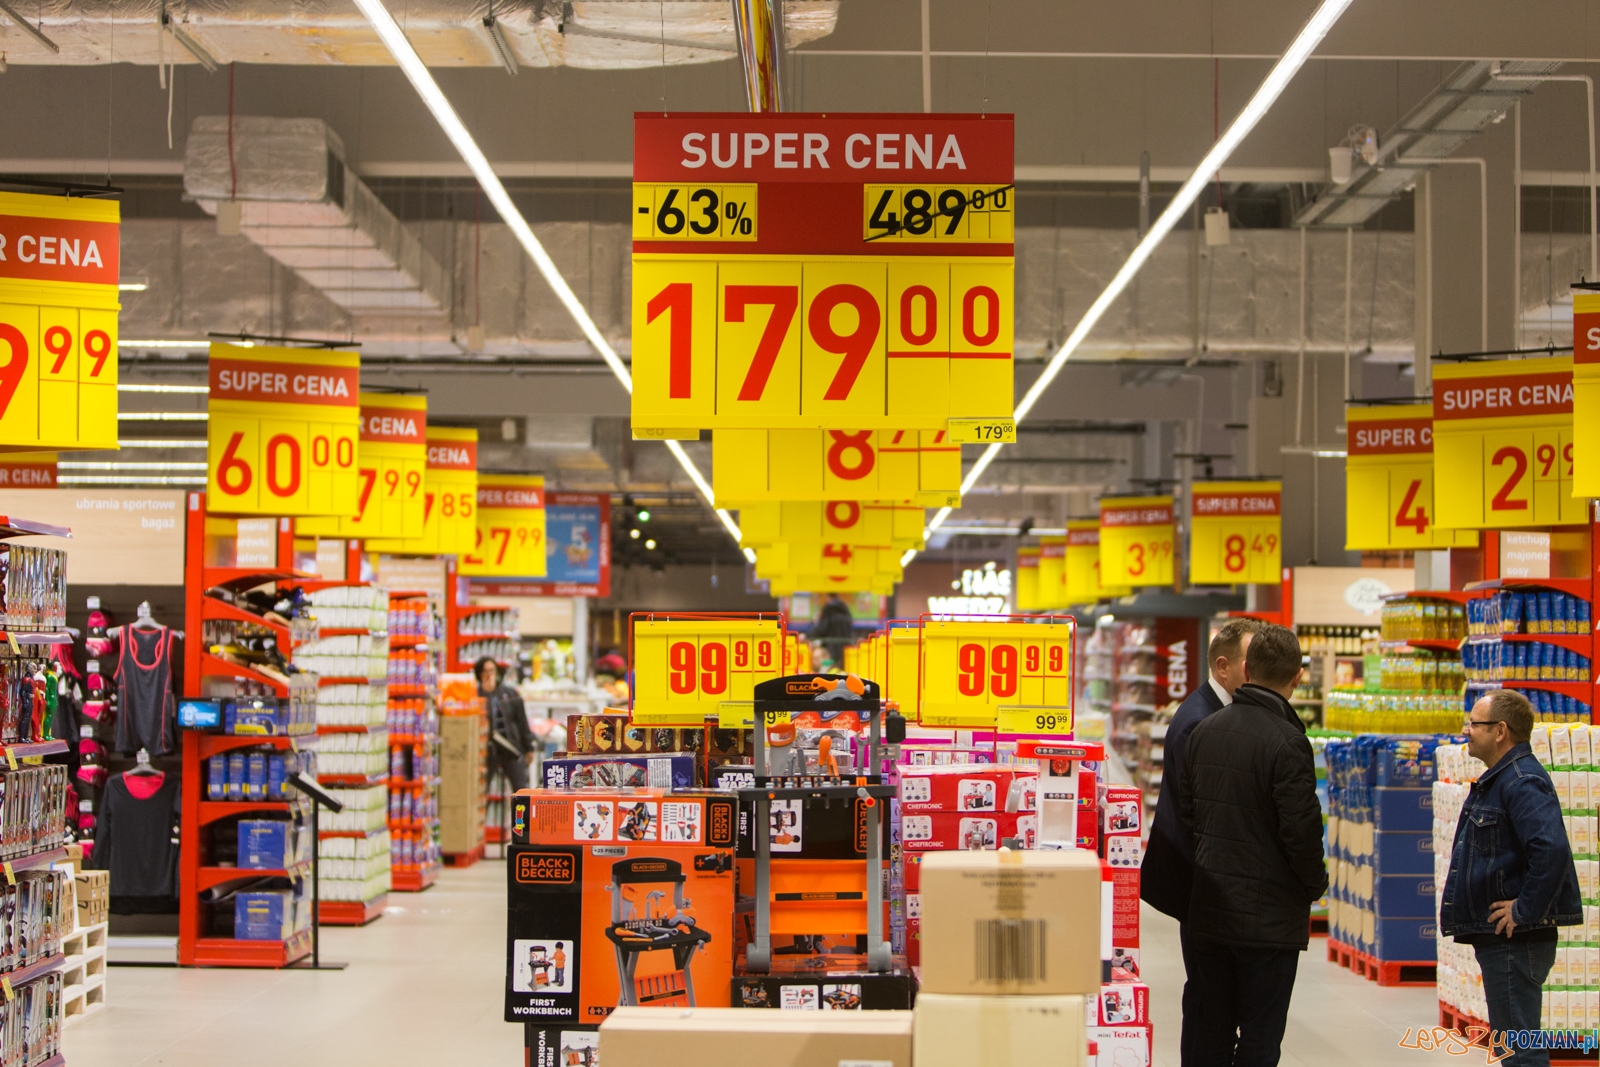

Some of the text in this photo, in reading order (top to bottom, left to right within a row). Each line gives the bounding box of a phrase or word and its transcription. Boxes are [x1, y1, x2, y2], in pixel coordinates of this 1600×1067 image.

[681, 132, 967, 170] SUPER CENA
[638, 188, 752, 236] -63%
[17, 235, 104, 268] CENA
[218, 370, 349, 398] SUPER CENA
[1443, 382, 1574, 411] SUPER CENA
[370, 417, 418, 437] CENA
[1356, 428, 1415, 448] SUPER
[428, 448, 470, 465] CENA
[12, 468, 51, 484] CENA
[76, 498, 175, 513] ubrania sportowe
[505, 491, 540, 505] CENA
[1197, 497, 1276, 513] SUPER CENA
[141, 515, 175, 531] bagaż
[1103, 509, 1170, 525] SUPER CENA
[1506, 567, 1529, 579] sosy
[1167, 640, 1188, 698] CENA
[722, 772, 755, 782] STAR
[1108, 792, 1139, 800] CHEFTRONIC
[713, 806, 721, 840] DECKER
[740, 811, 748, 836] FIRST
[521, 858, 570, 869] BLACK+
[521, 868, 570, 879] DECKER
[513, 1006, 572, 1016] WORKBENCH
[530, 999, 556, 1007] FIRST
[1112, 1030, 1141, 1039] Tefal
